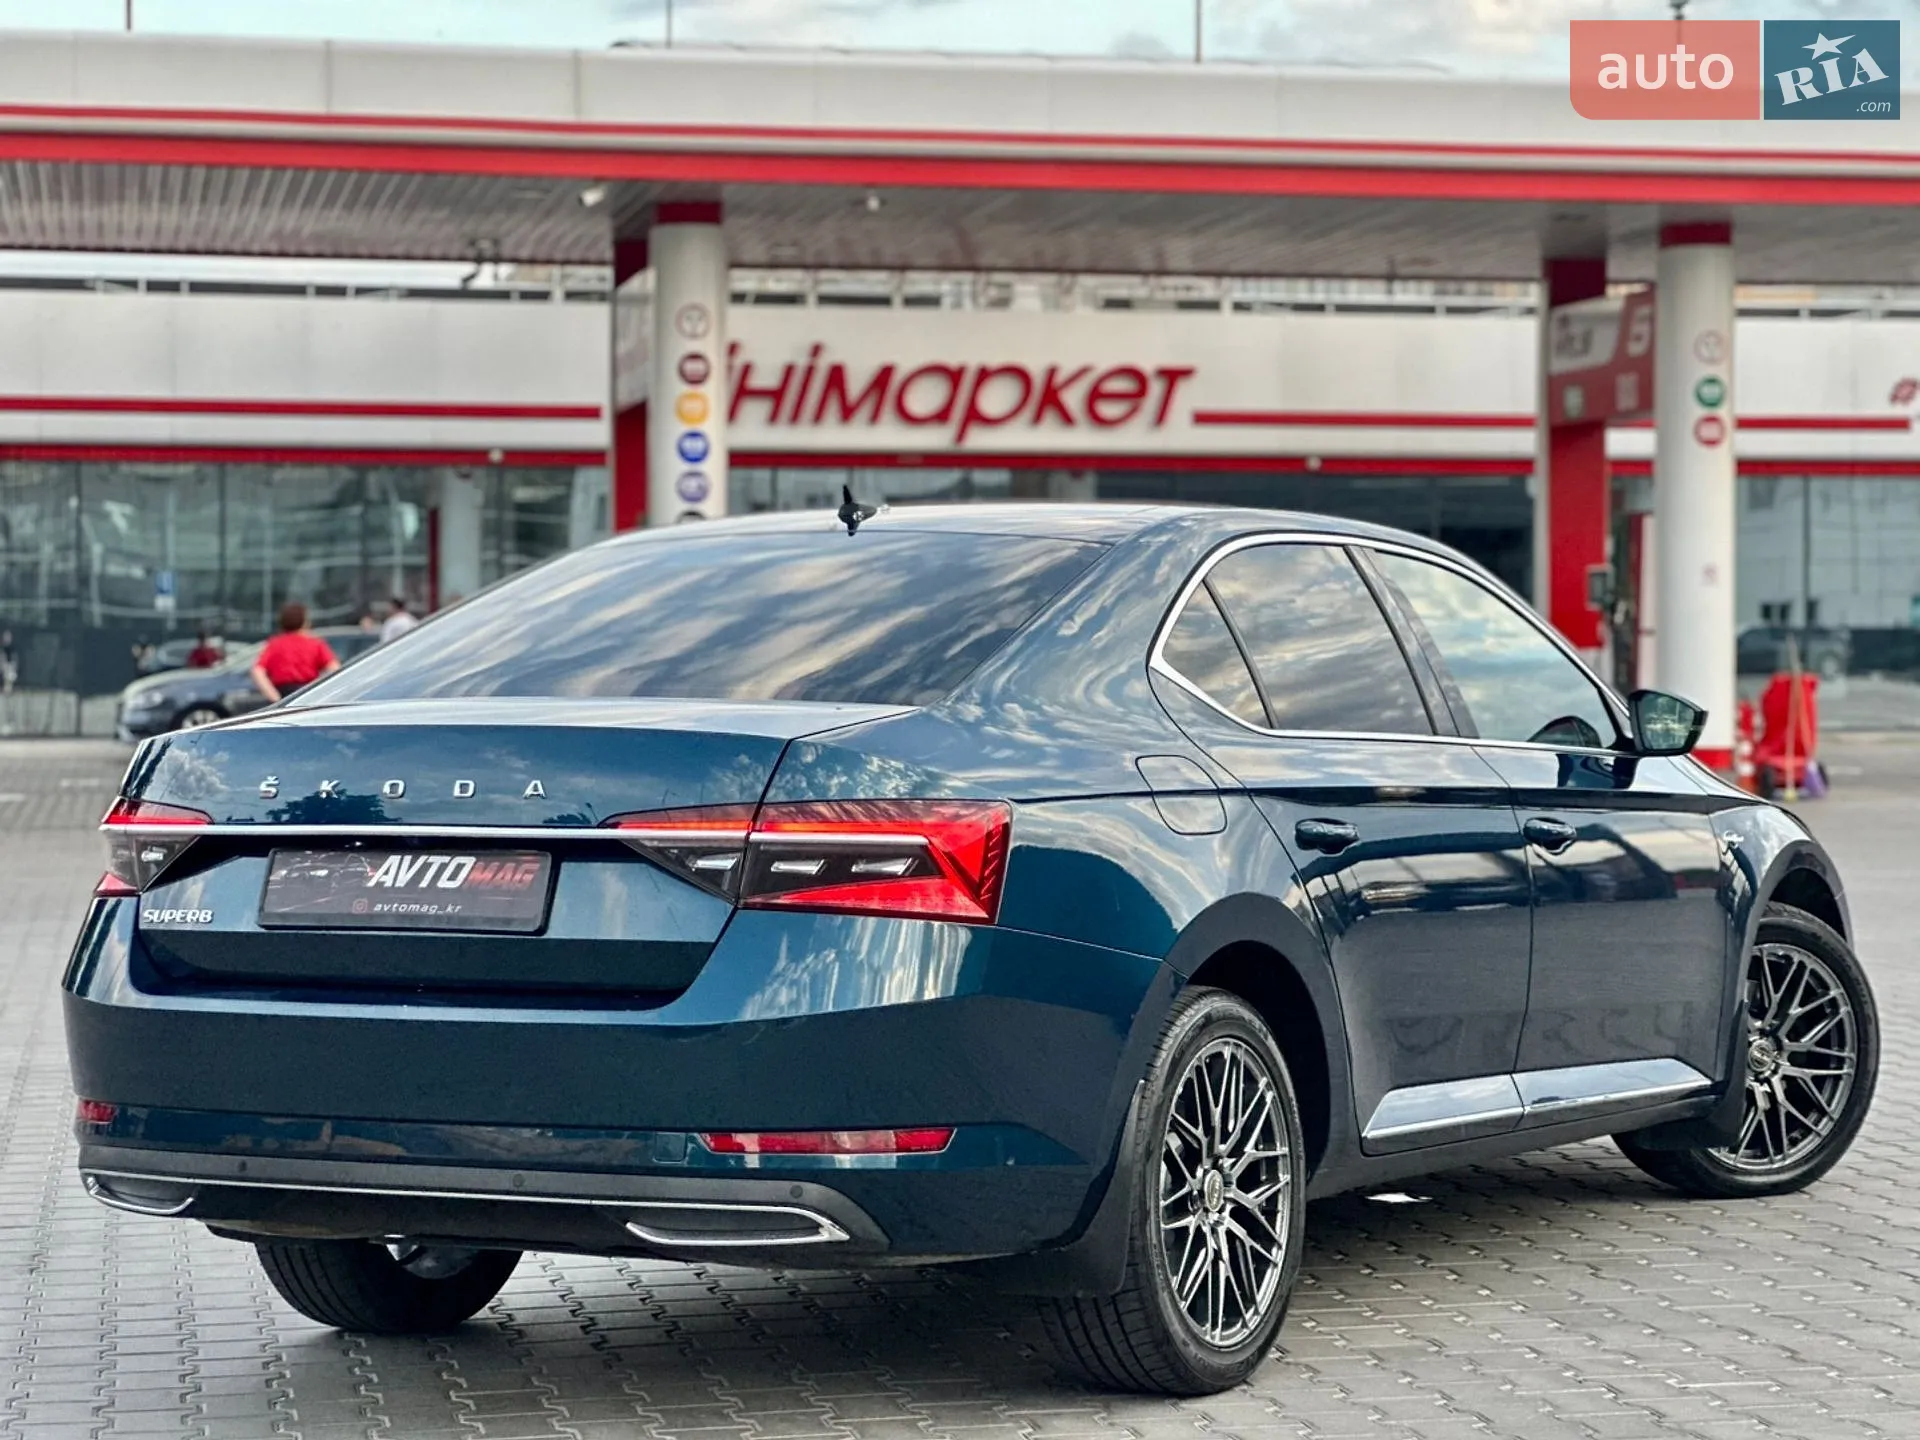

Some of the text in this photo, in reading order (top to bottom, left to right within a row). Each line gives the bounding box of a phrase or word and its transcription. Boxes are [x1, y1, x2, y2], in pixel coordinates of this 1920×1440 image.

[258, 775, 548, 800] ŠKODA
[373, 902, 462, 915] avtomag_kr
[143, 909, 213, 925] SUPERB
